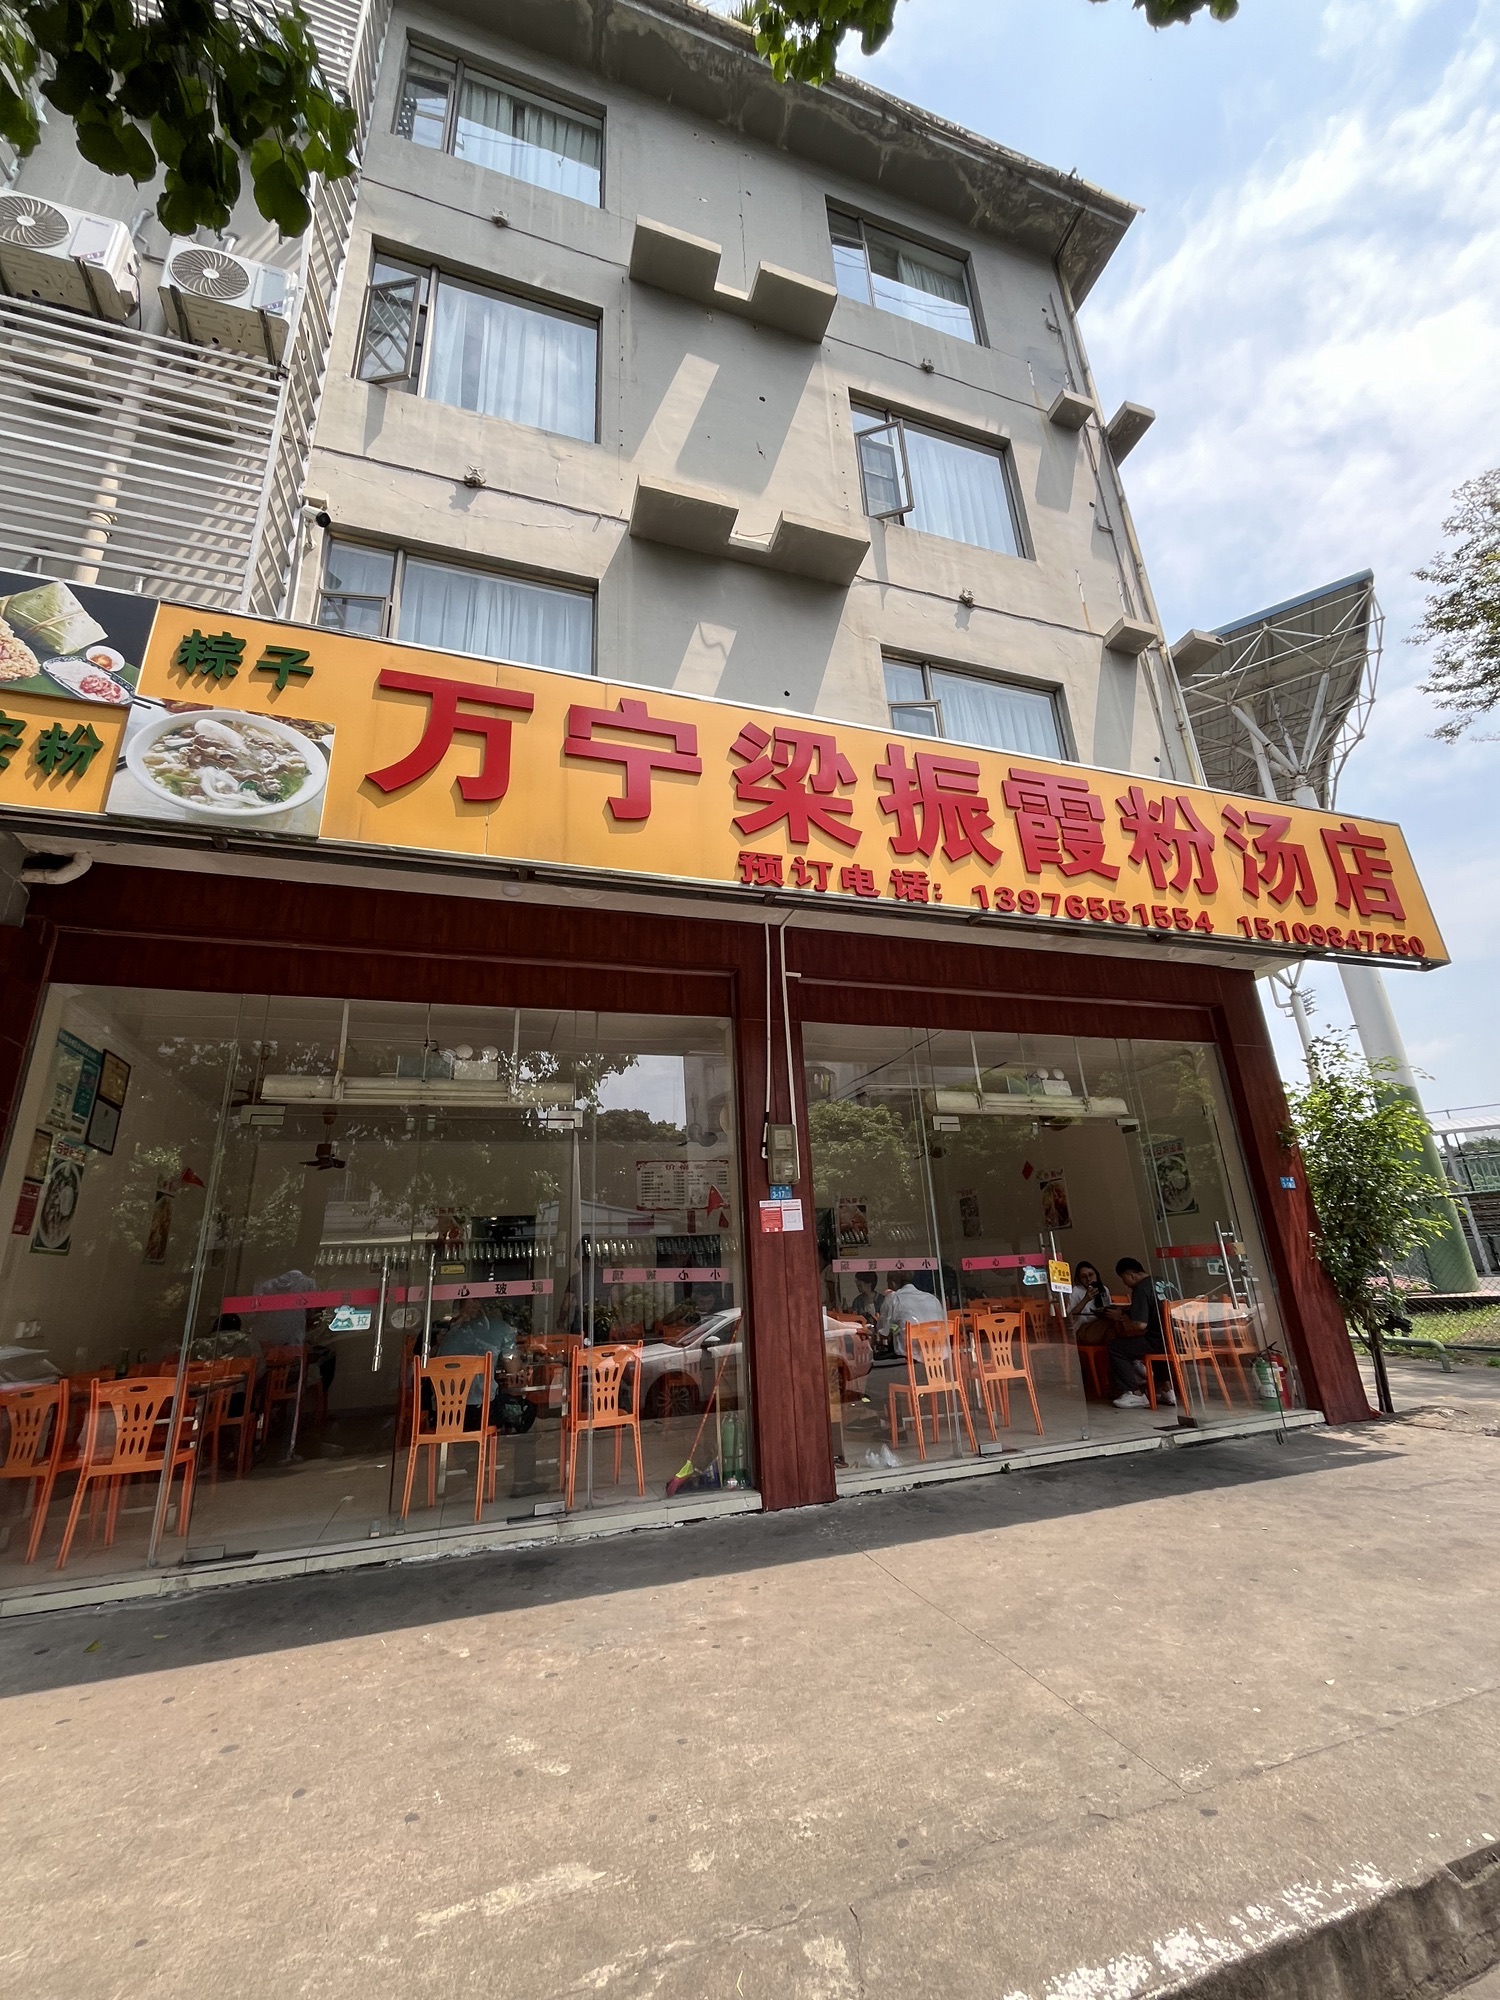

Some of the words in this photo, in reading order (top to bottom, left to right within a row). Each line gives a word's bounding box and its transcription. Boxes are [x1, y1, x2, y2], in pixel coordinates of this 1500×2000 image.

[177, 628, 314, 691] 粽子
[365, 668, 1407, 921] 万宁梁振霞粉汤店
[738, 850, 943, 903] 预订电话：
[971, 884, 1214, 933] 13976551554
[1237, 915, 1426, 957] 15109847250
[356, 1315, 369, 1327] 拉
